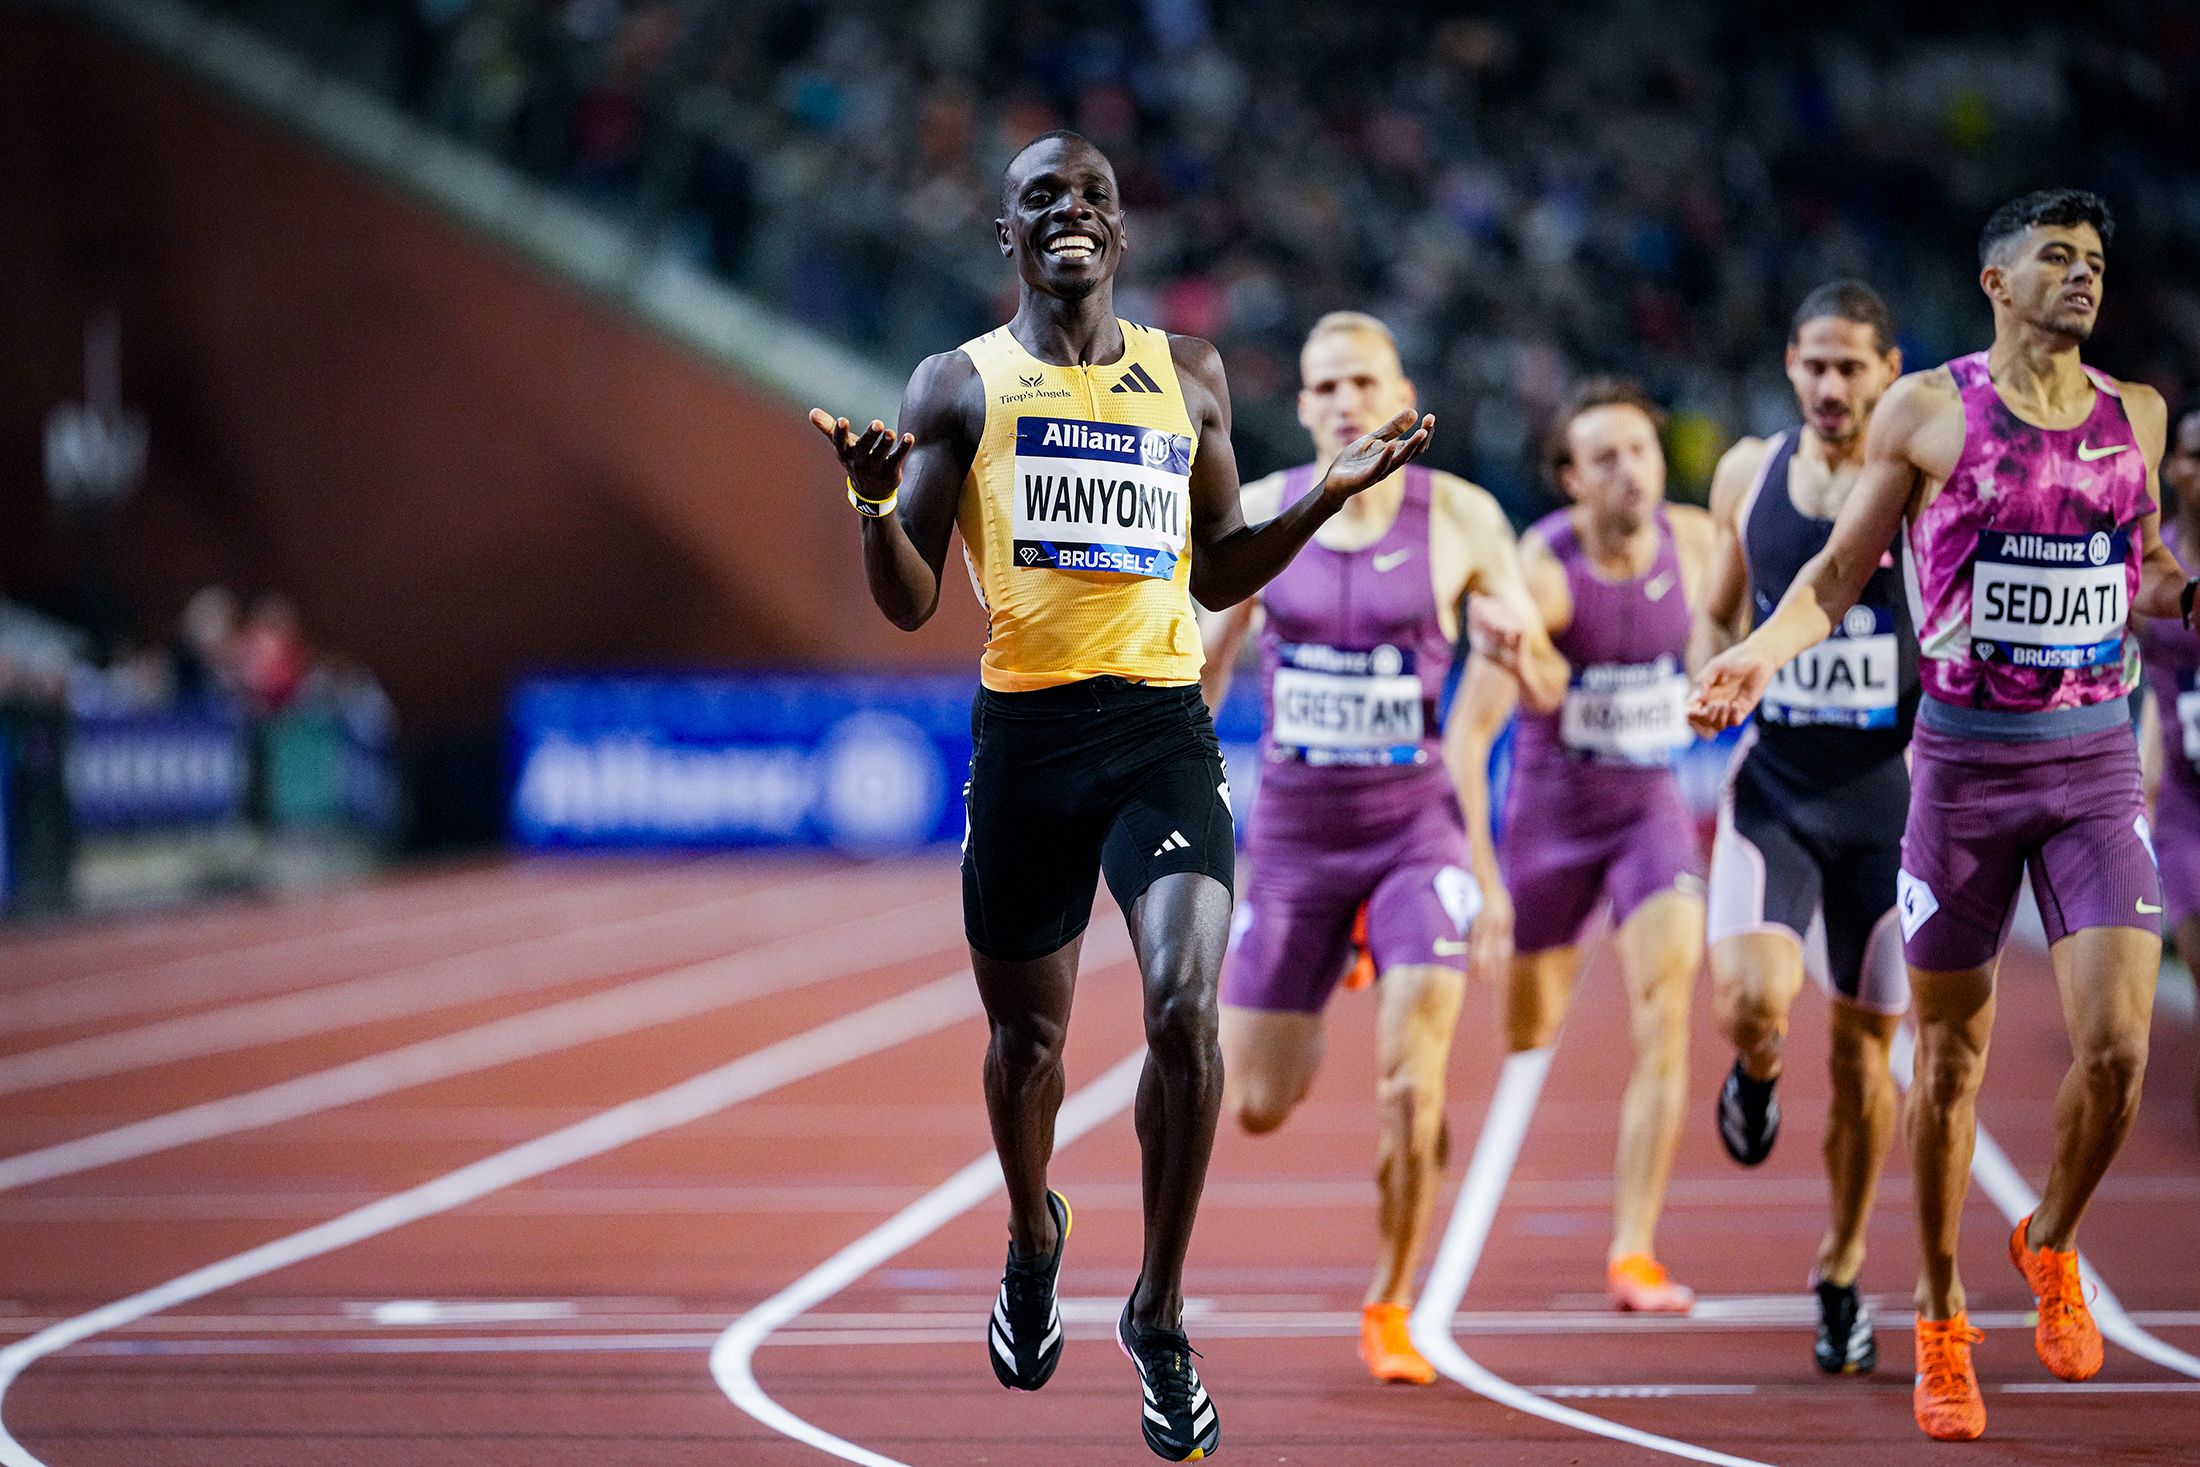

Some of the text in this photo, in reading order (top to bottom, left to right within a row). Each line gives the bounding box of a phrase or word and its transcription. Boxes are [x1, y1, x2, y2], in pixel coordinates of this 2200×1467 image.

[999, 389, 1071, 404] Tirop's Angels
[1042, 423, 1136, 453] Allianz
[1025, 474, 1179, 536] WANYONYI
[1059, 549, 1155, 573] BRUSSELS
[2000, 534, 2087, 562] Allianz
[1984, 581, 2118, 626] SEDJATI
[2012, 646, 2097, 667] BRUSSELS
